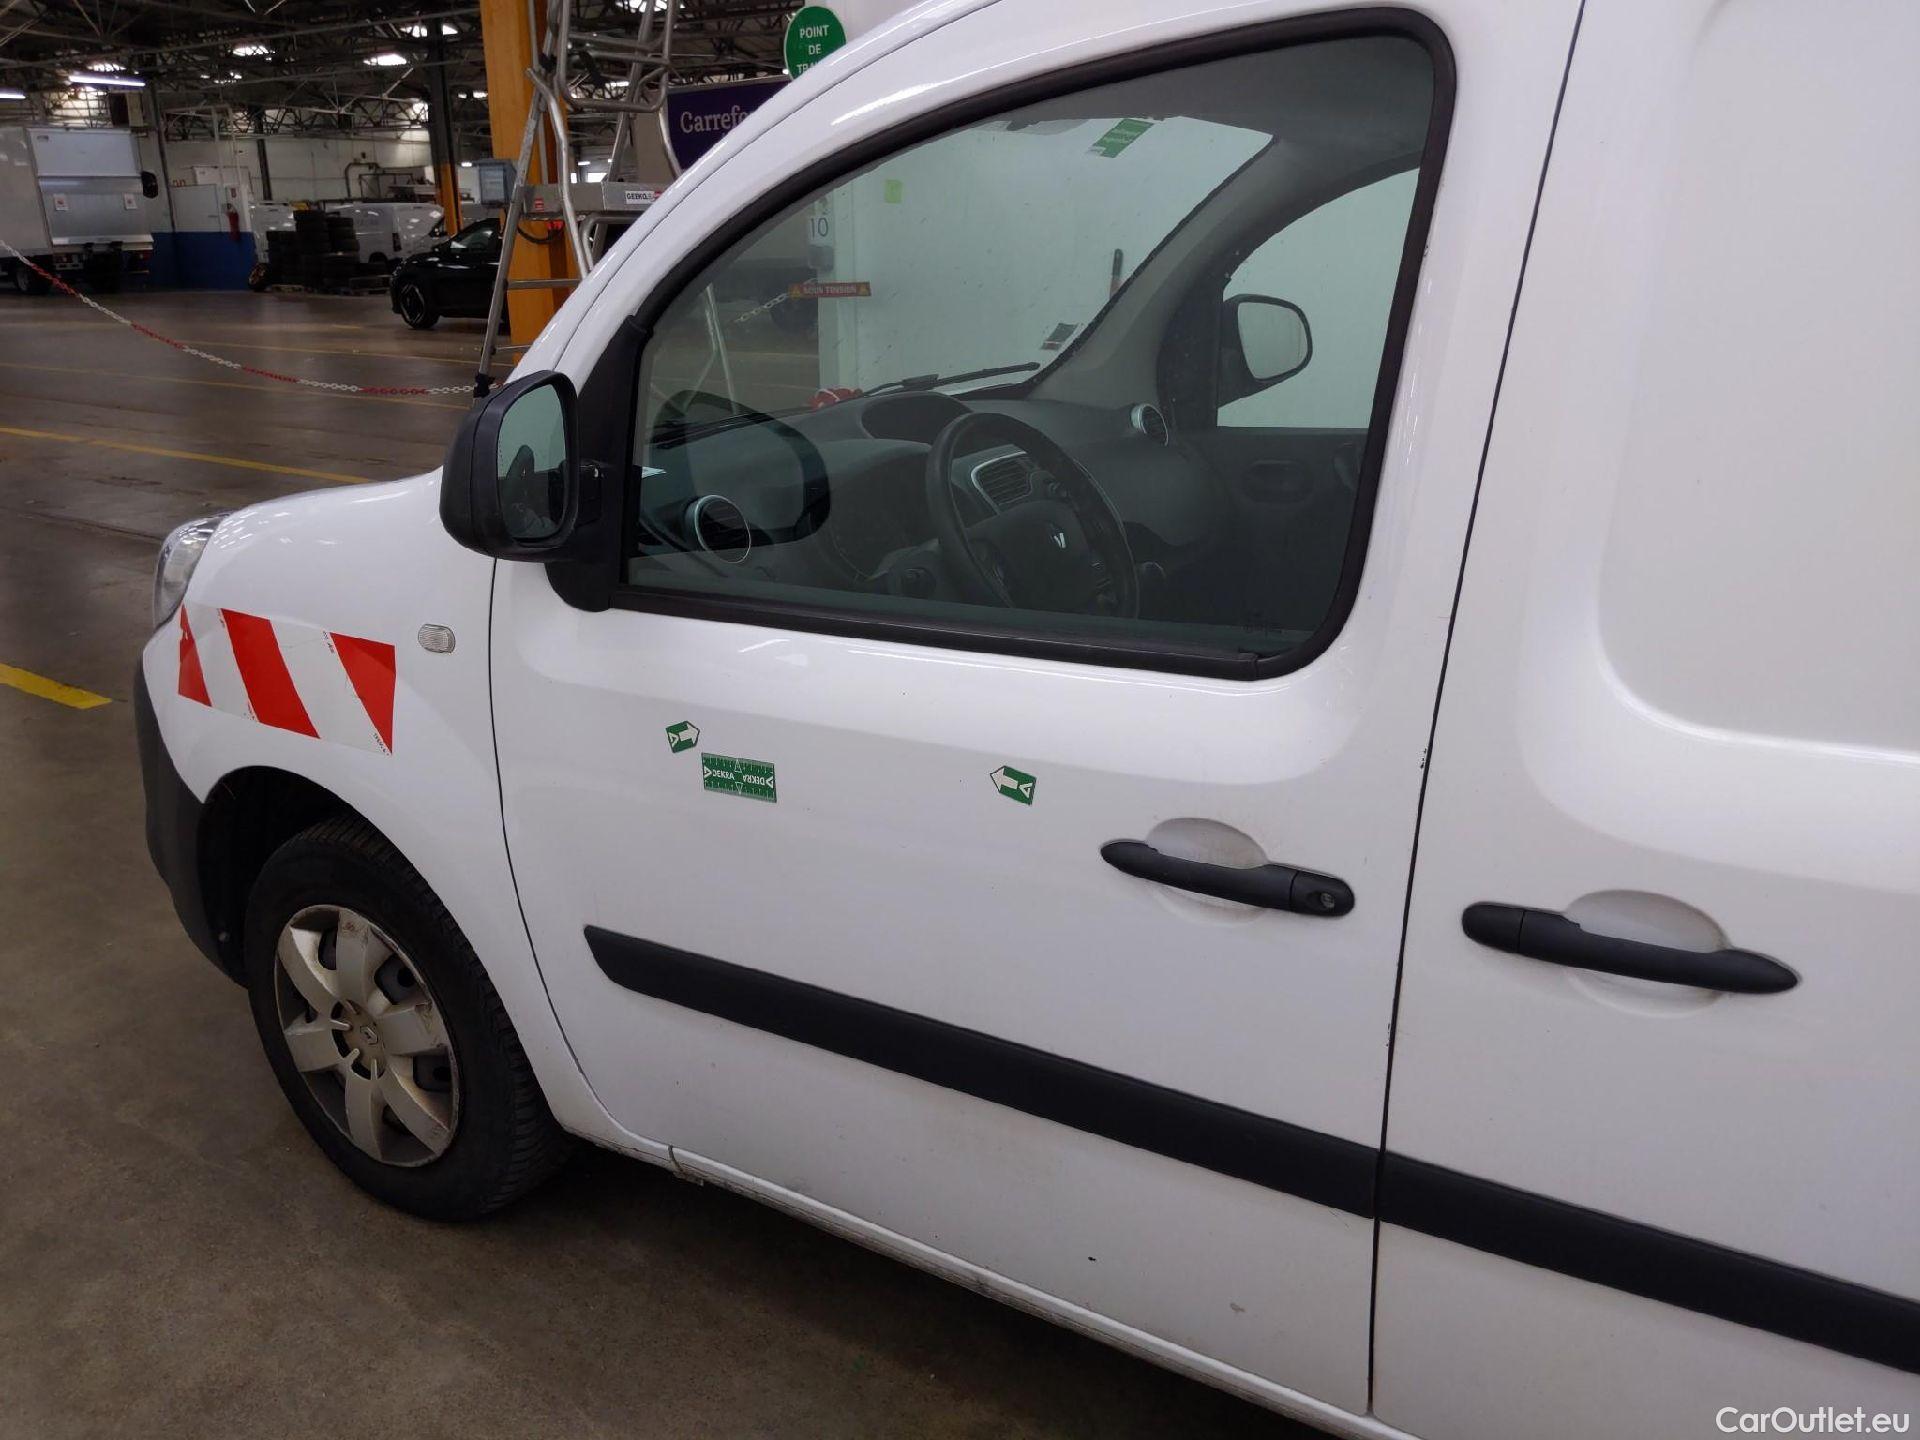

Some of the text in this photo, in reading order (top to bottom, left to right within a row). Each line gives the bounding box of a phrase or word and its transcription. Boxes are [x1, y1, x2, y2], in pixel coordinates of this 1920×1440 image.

[800, 25, 829, 38] POINT
[808, 44, 821, 55] DE
[811, 217, 829, 240] 10
[712, 769, 735, 780] DEKRA
[742, 774, 766, 786] DEKRA
